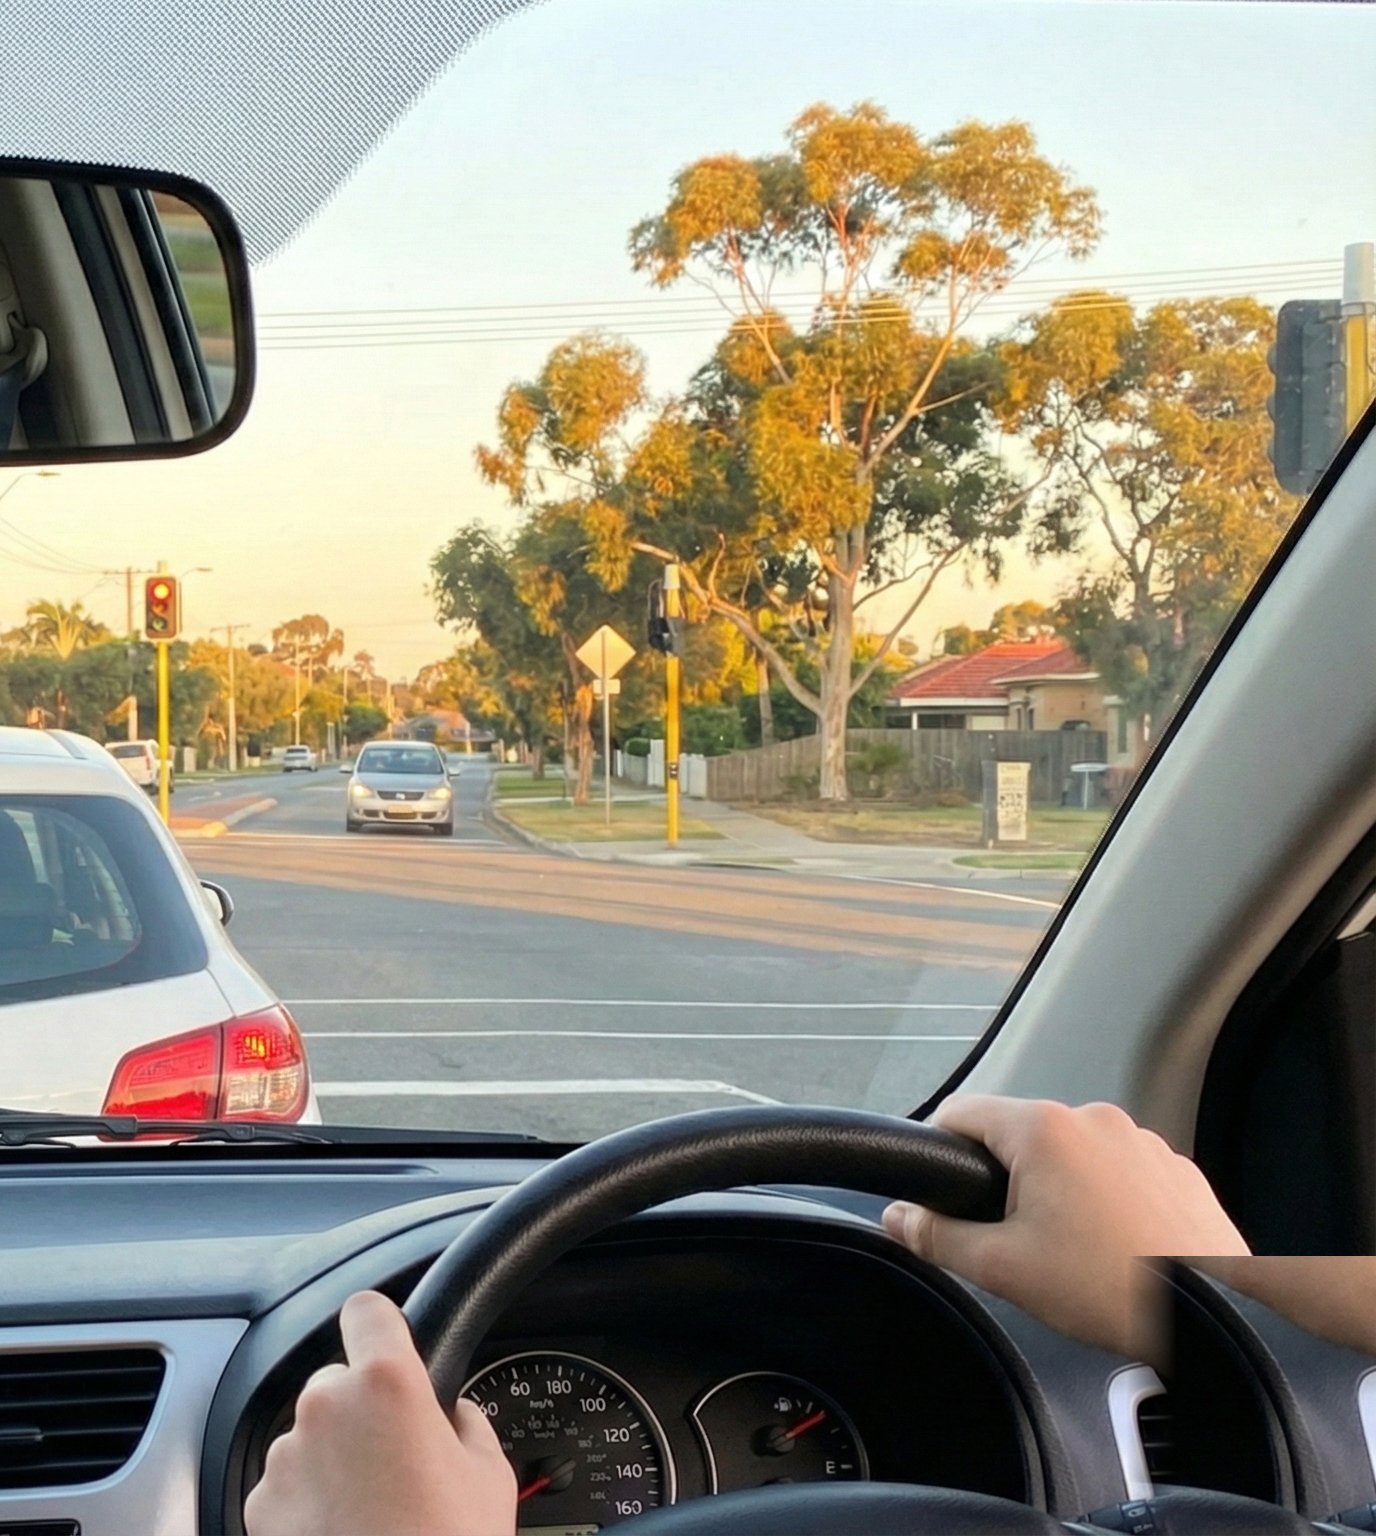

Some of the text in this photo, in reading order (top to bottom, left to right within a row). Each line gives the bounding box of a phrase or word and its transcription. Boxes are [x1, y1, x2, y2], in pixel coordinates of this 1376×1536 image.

[510, 1382, 531, 1396] 60
[546, 1380, 572, 1395] 180
[579, 1397, 606, 1412] 100
[603, 1428, 630, 1443] 120
[616, 1464, 643, 1479] 140
[826, 1461, 836, 1474] E
[615, 1500, 642, 1515] 160
